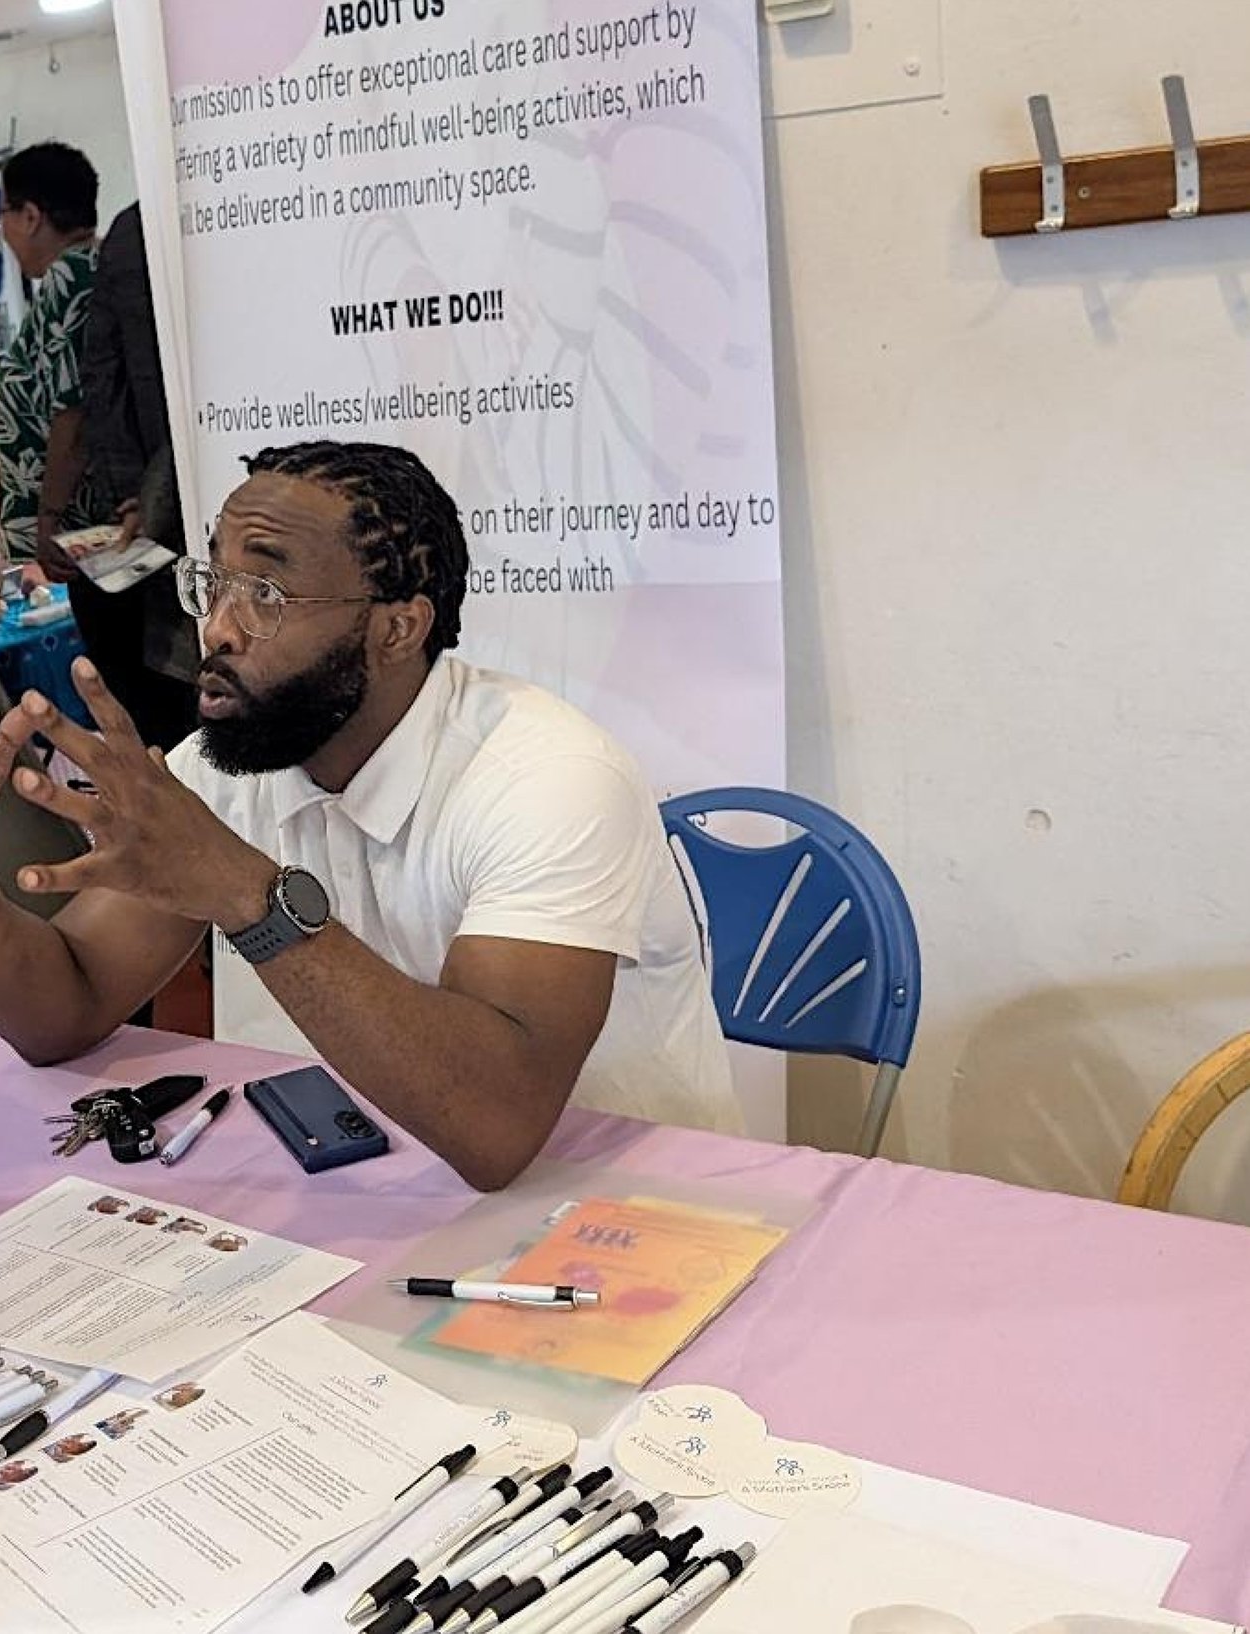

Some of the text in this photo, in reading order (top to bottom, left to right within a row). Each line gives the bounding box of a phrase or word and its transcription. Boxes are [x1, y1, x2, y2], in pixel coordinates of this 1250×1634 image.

[325, 0, 445, 37] ABOUT US
[190, 79, 254, 121] mission
[258, 74, 274, 109] is
[279, 75, 300, 105] to
[306, 62, 353, 102] offer
[360, 38, 478, 96] exceptional
[483, 38, 526, 73] care
[533, 21, 570, 64] and
[576, 7, 661, 62] support
[667, 0, 696, 49] by
[227, 146, 237, 172] a
[240, 130, 307, 172] variety
[314, 122, 333, 159] of
[339, 110, 417, 156] mindful
[422, 98, 528, 140] well-being
[532, 80, 631, 127] activities,
[637, 64, 705, 110] which
[196, 202, 213, 233] be
[218, 184, 304, 230] delivered
[310, 184, 327, 219] in
[334, 189, 345, 216] a
[350, 167, 464, 211] community
[470, 163, 536, 206] space.
[330, 288, 504, 336] WHAT WE DO!!!
[207, 374, 574, 432] Provide wellness/wellbeing activities
[471, 508, 497, 535] on
[504, 496, 554, 534] their
[559, 496, 641, 541] journey
[649, 492, 689, 530] and
[697, 490, 740, 538] day
[748, 493, 775, 526] to
[469, 555, 614, 594] be faced with
